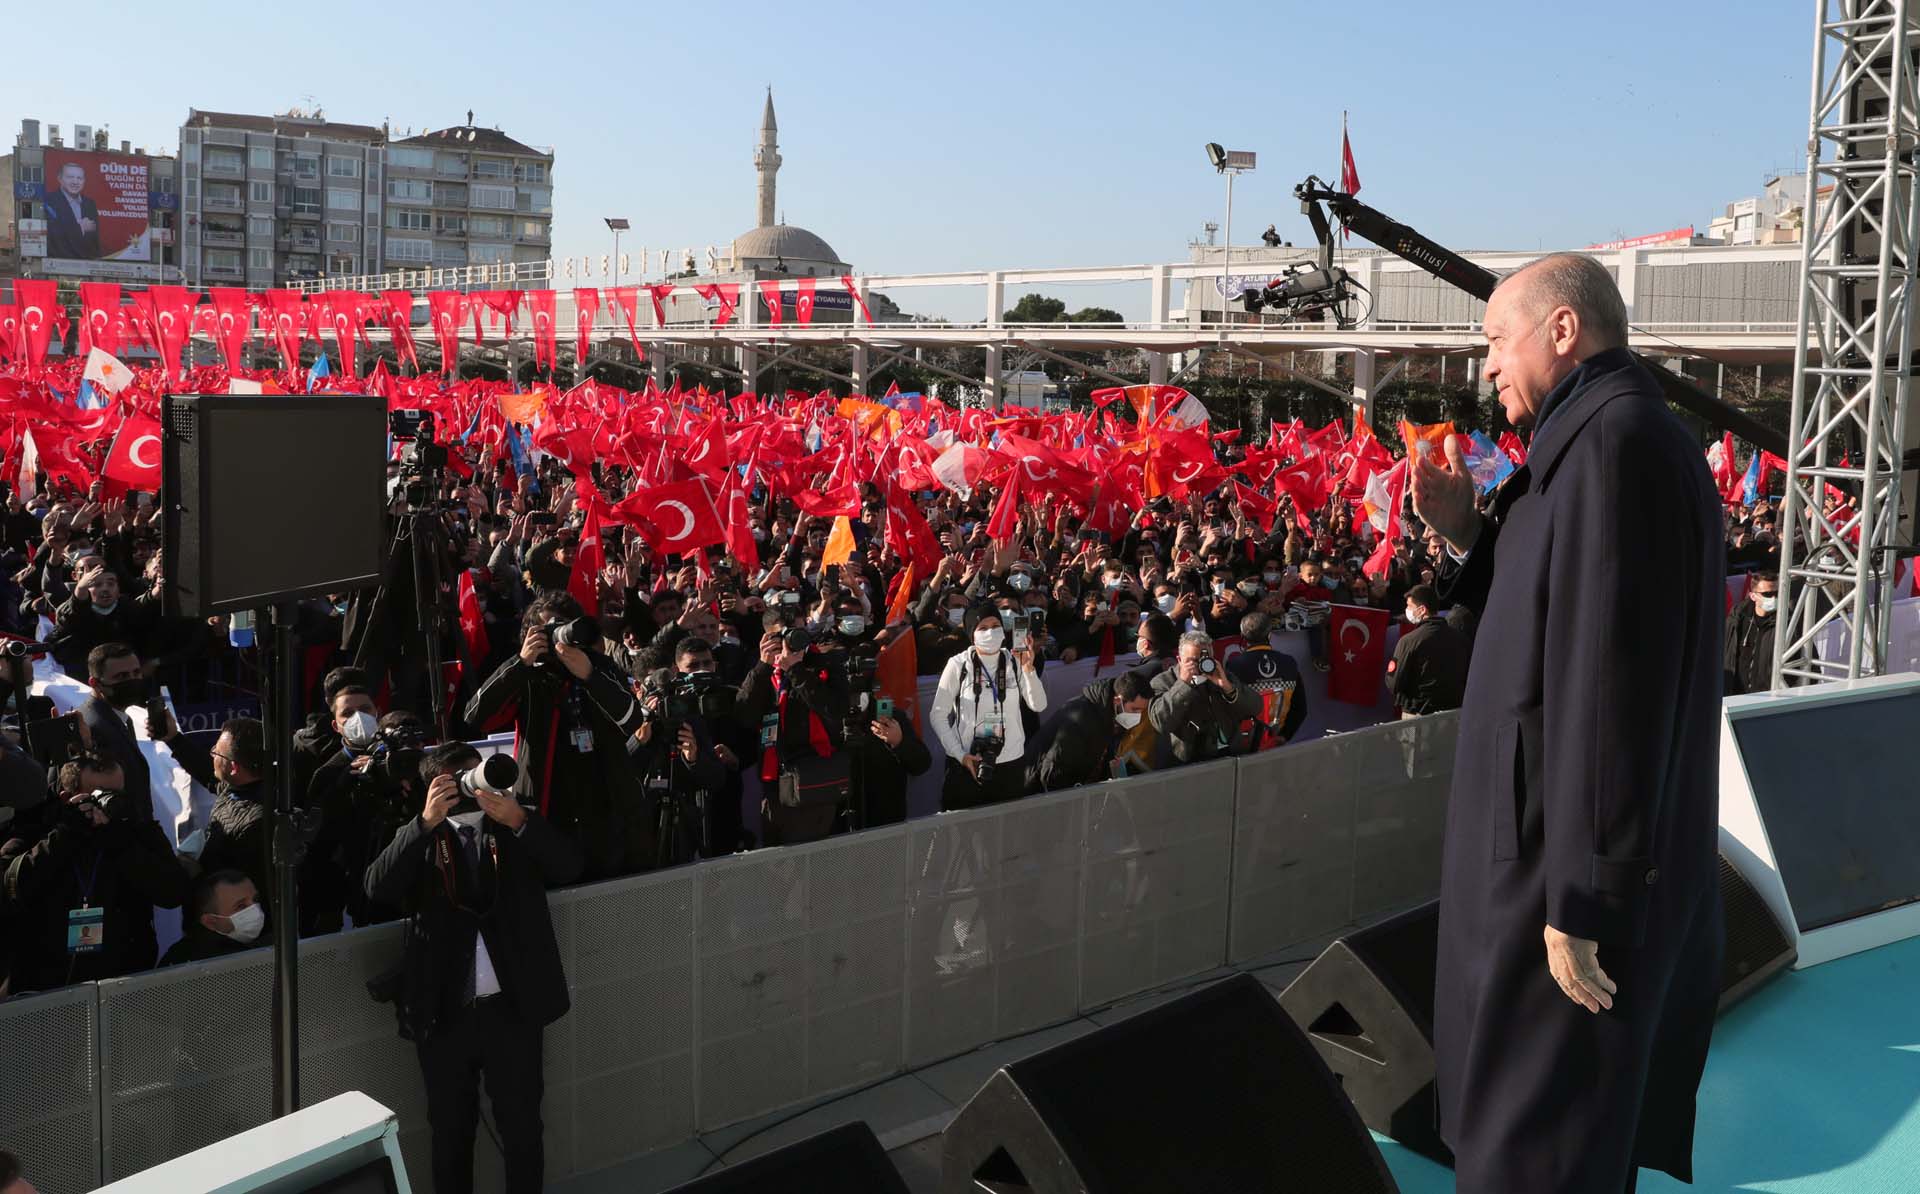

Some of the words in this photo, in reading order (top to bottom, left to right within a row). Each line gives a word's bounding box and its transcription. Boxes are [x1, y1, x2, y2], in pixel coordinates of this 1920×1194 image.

[100, 162, 128, 174] DÜN
[130, 165, 148, 175] DE
[105, 173, 135, 183] BUGÜN
[136, 175, 148, 183] DE
[109, 182, 134, 190] YARIN
[1411, 246, 1442, 268] Altus
[440, 839, 450, 864] Canon
